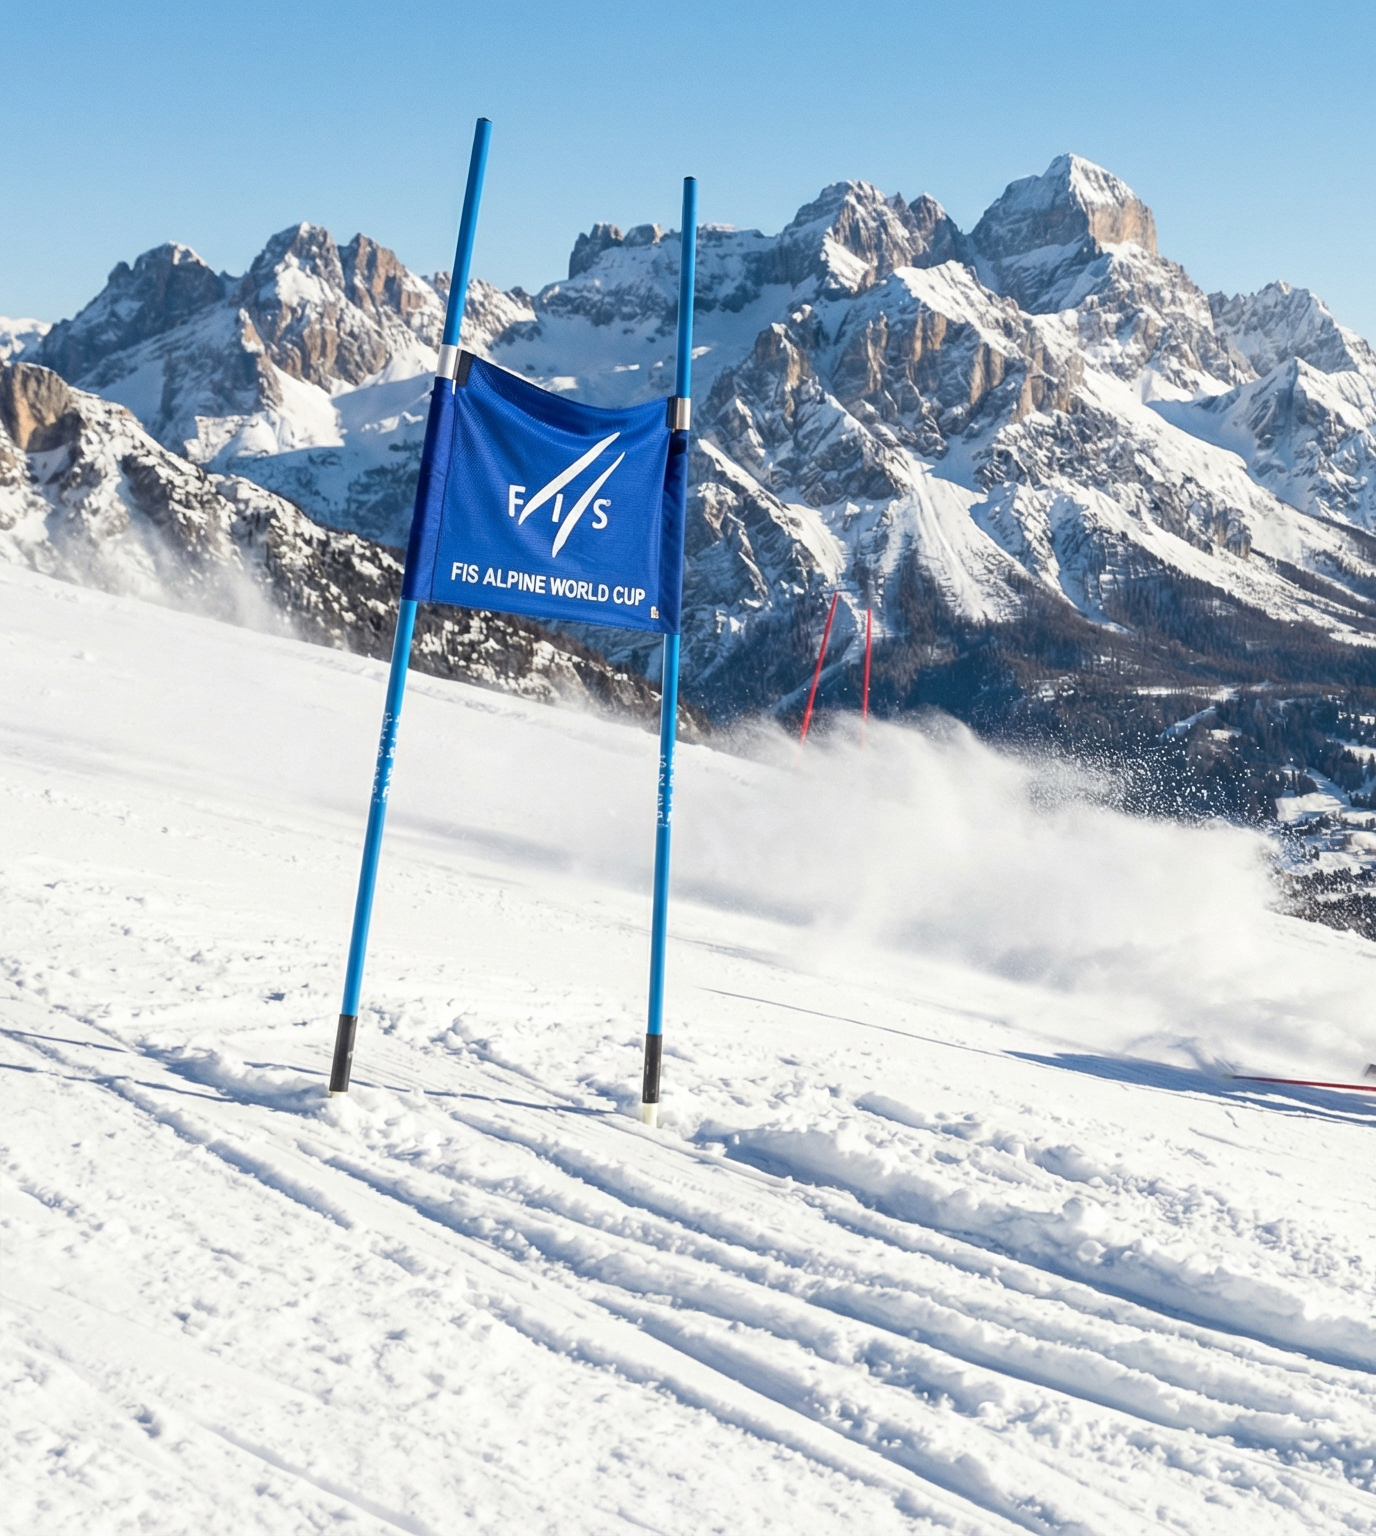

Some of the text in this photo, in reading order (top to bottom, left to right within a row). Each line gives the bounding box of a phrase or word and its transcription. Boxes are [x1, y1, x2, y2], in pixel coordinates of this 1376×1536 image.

[451, 562, 646, 606] FIS ALPINE WORLD CUP
